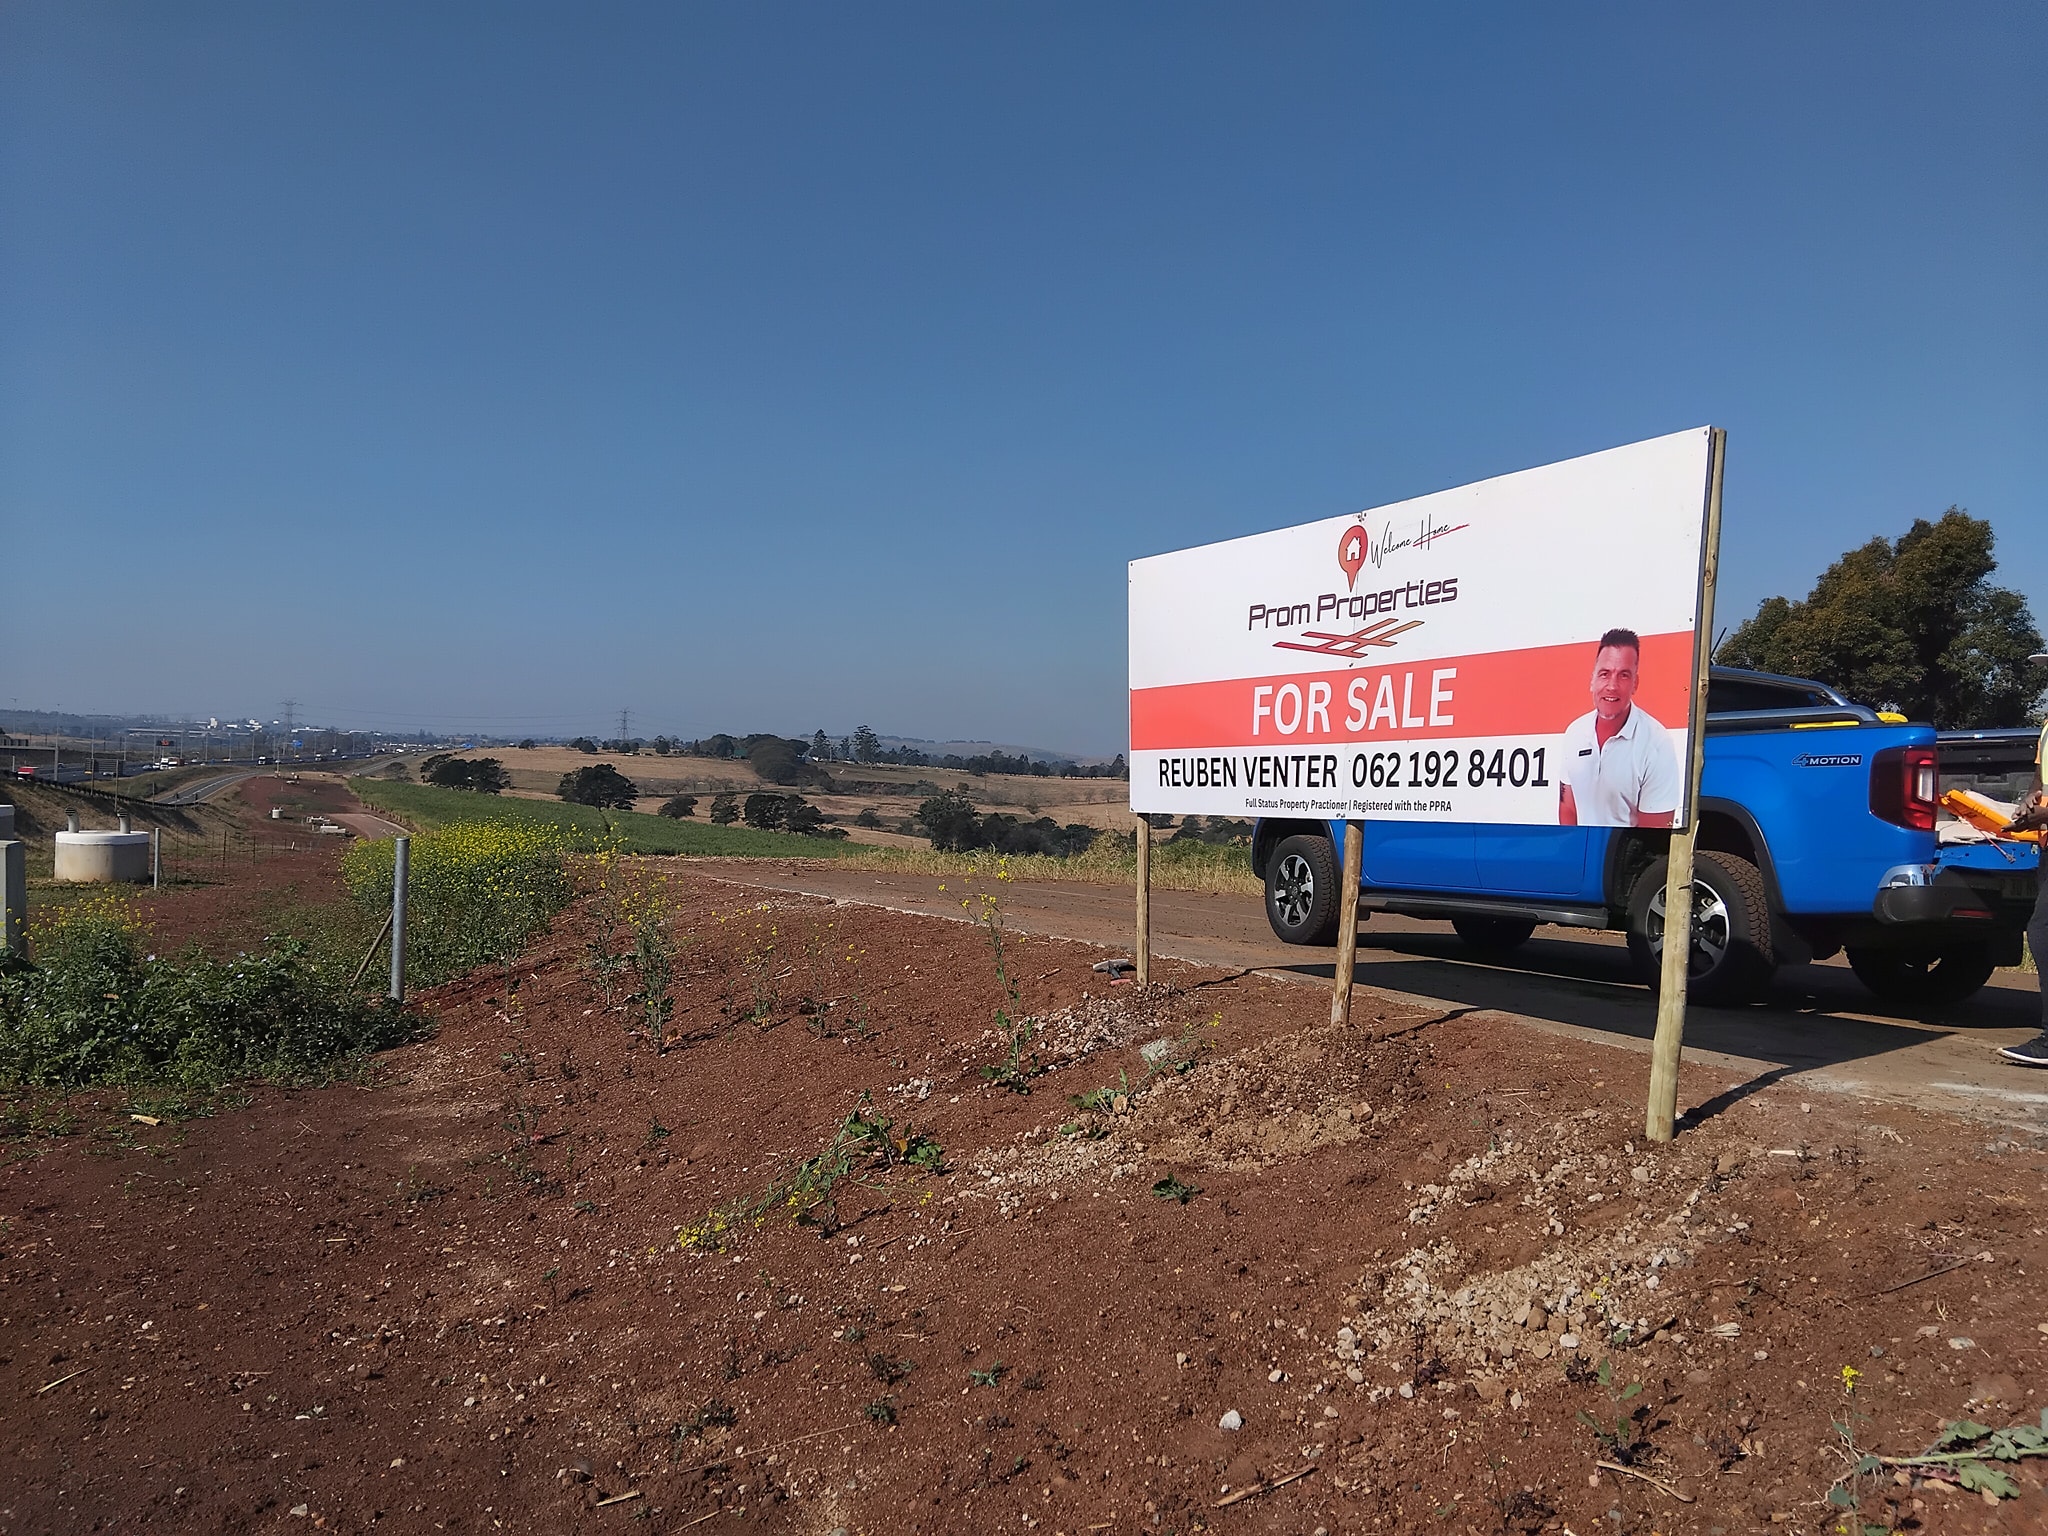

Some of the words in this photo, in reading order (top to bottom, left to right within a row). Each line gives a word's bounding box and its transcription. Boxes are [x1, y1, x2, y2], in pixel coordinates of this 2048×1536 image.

[1371, 521, 1411, 568] Welcome
[1413, 514, 1450, 550] Home
[1249, 603, 1310, 630] Prom
[1317, 578, 1458, 621] Properties
[1253, 681, 1332, 735] FOR
[1345, 667, 1457, 732] SALE
[1159, 757, 1236, 787] REUBEN
[1243, 755, 1338, 788] VENTER
[1352, 752, 1401, 787] 062
[1408, 750, 1459, 787] 192
[1467, 747, 1549, 787] 8401
[1792, 752, 1860, 766] 4MOTION
[1245, 798, 1257, 808] Full
[1258, 799, 1279, 808] Status
[1280, 799, 1309, 811] Property
[1311, 799, 1347, 810] Practioner
[1353, 799, 1392, 812] Registered
[1394, 800, 1411, 811] with
[1413, 800, 1427, 811] the
[1429, 801, 1452, 811] PPRA
